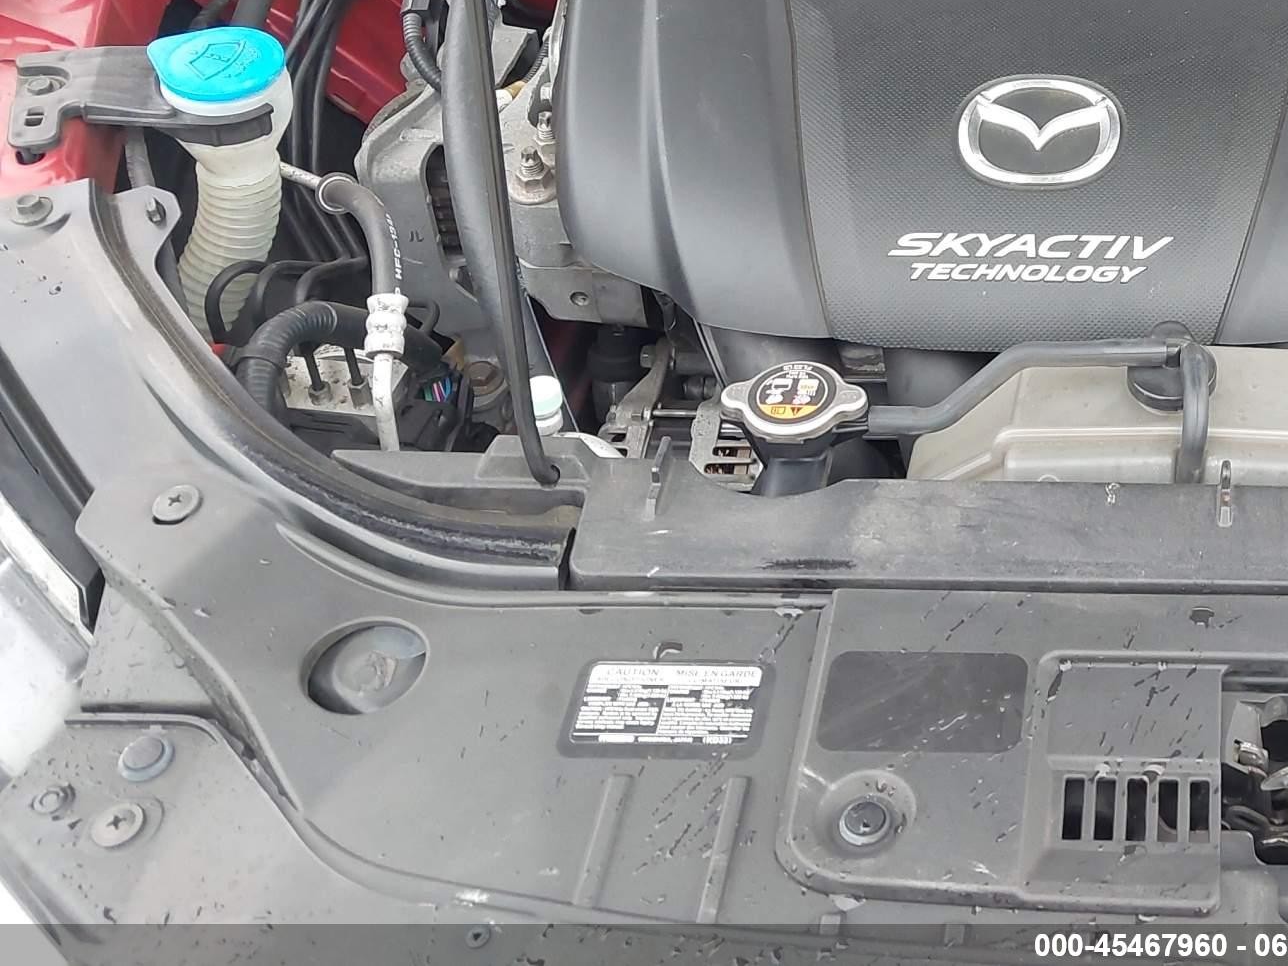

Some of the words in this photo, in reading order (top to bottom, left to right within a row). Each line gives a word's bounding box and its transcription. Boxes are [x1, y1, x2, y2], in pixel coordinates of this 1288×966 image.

[888, 233, 1174, 260] SKYACTIV
[909, 262, 1148, 284] TECHNOLOGY
[606, 667, 660, 677] CAUTION
[676, 669, 699, 677] MISE
[720, 670, 757, 678] GARDE
